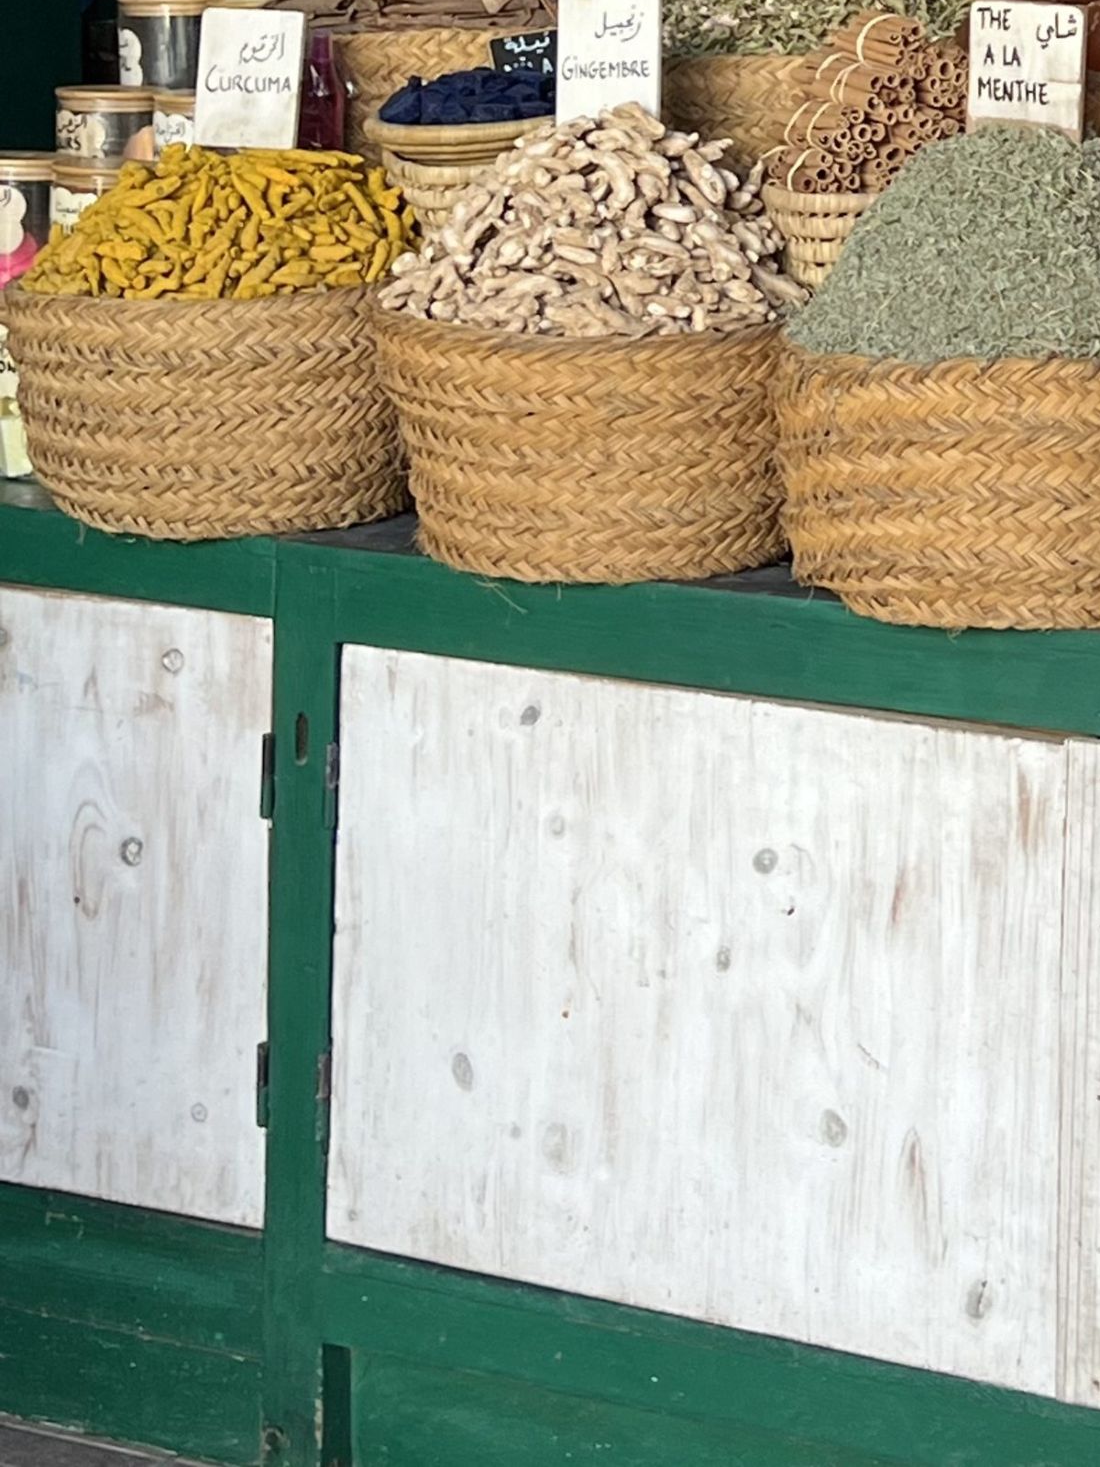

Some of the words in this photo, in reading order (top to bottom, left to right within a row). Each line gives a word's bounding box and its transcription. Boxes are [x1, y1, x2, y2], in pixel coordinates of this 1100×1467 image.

[976, 6, 1013, 31] THE
[1035, 12, 1079, 50] شاي
[560, 55, 651, 82] GINGEMBRE
[983, 43, 996, 67] A
[1001, 44, 1023, 67] LA
[204, 64, 293, 95] CURCUMA
[976, 75, 1051, 106] MENTHE
